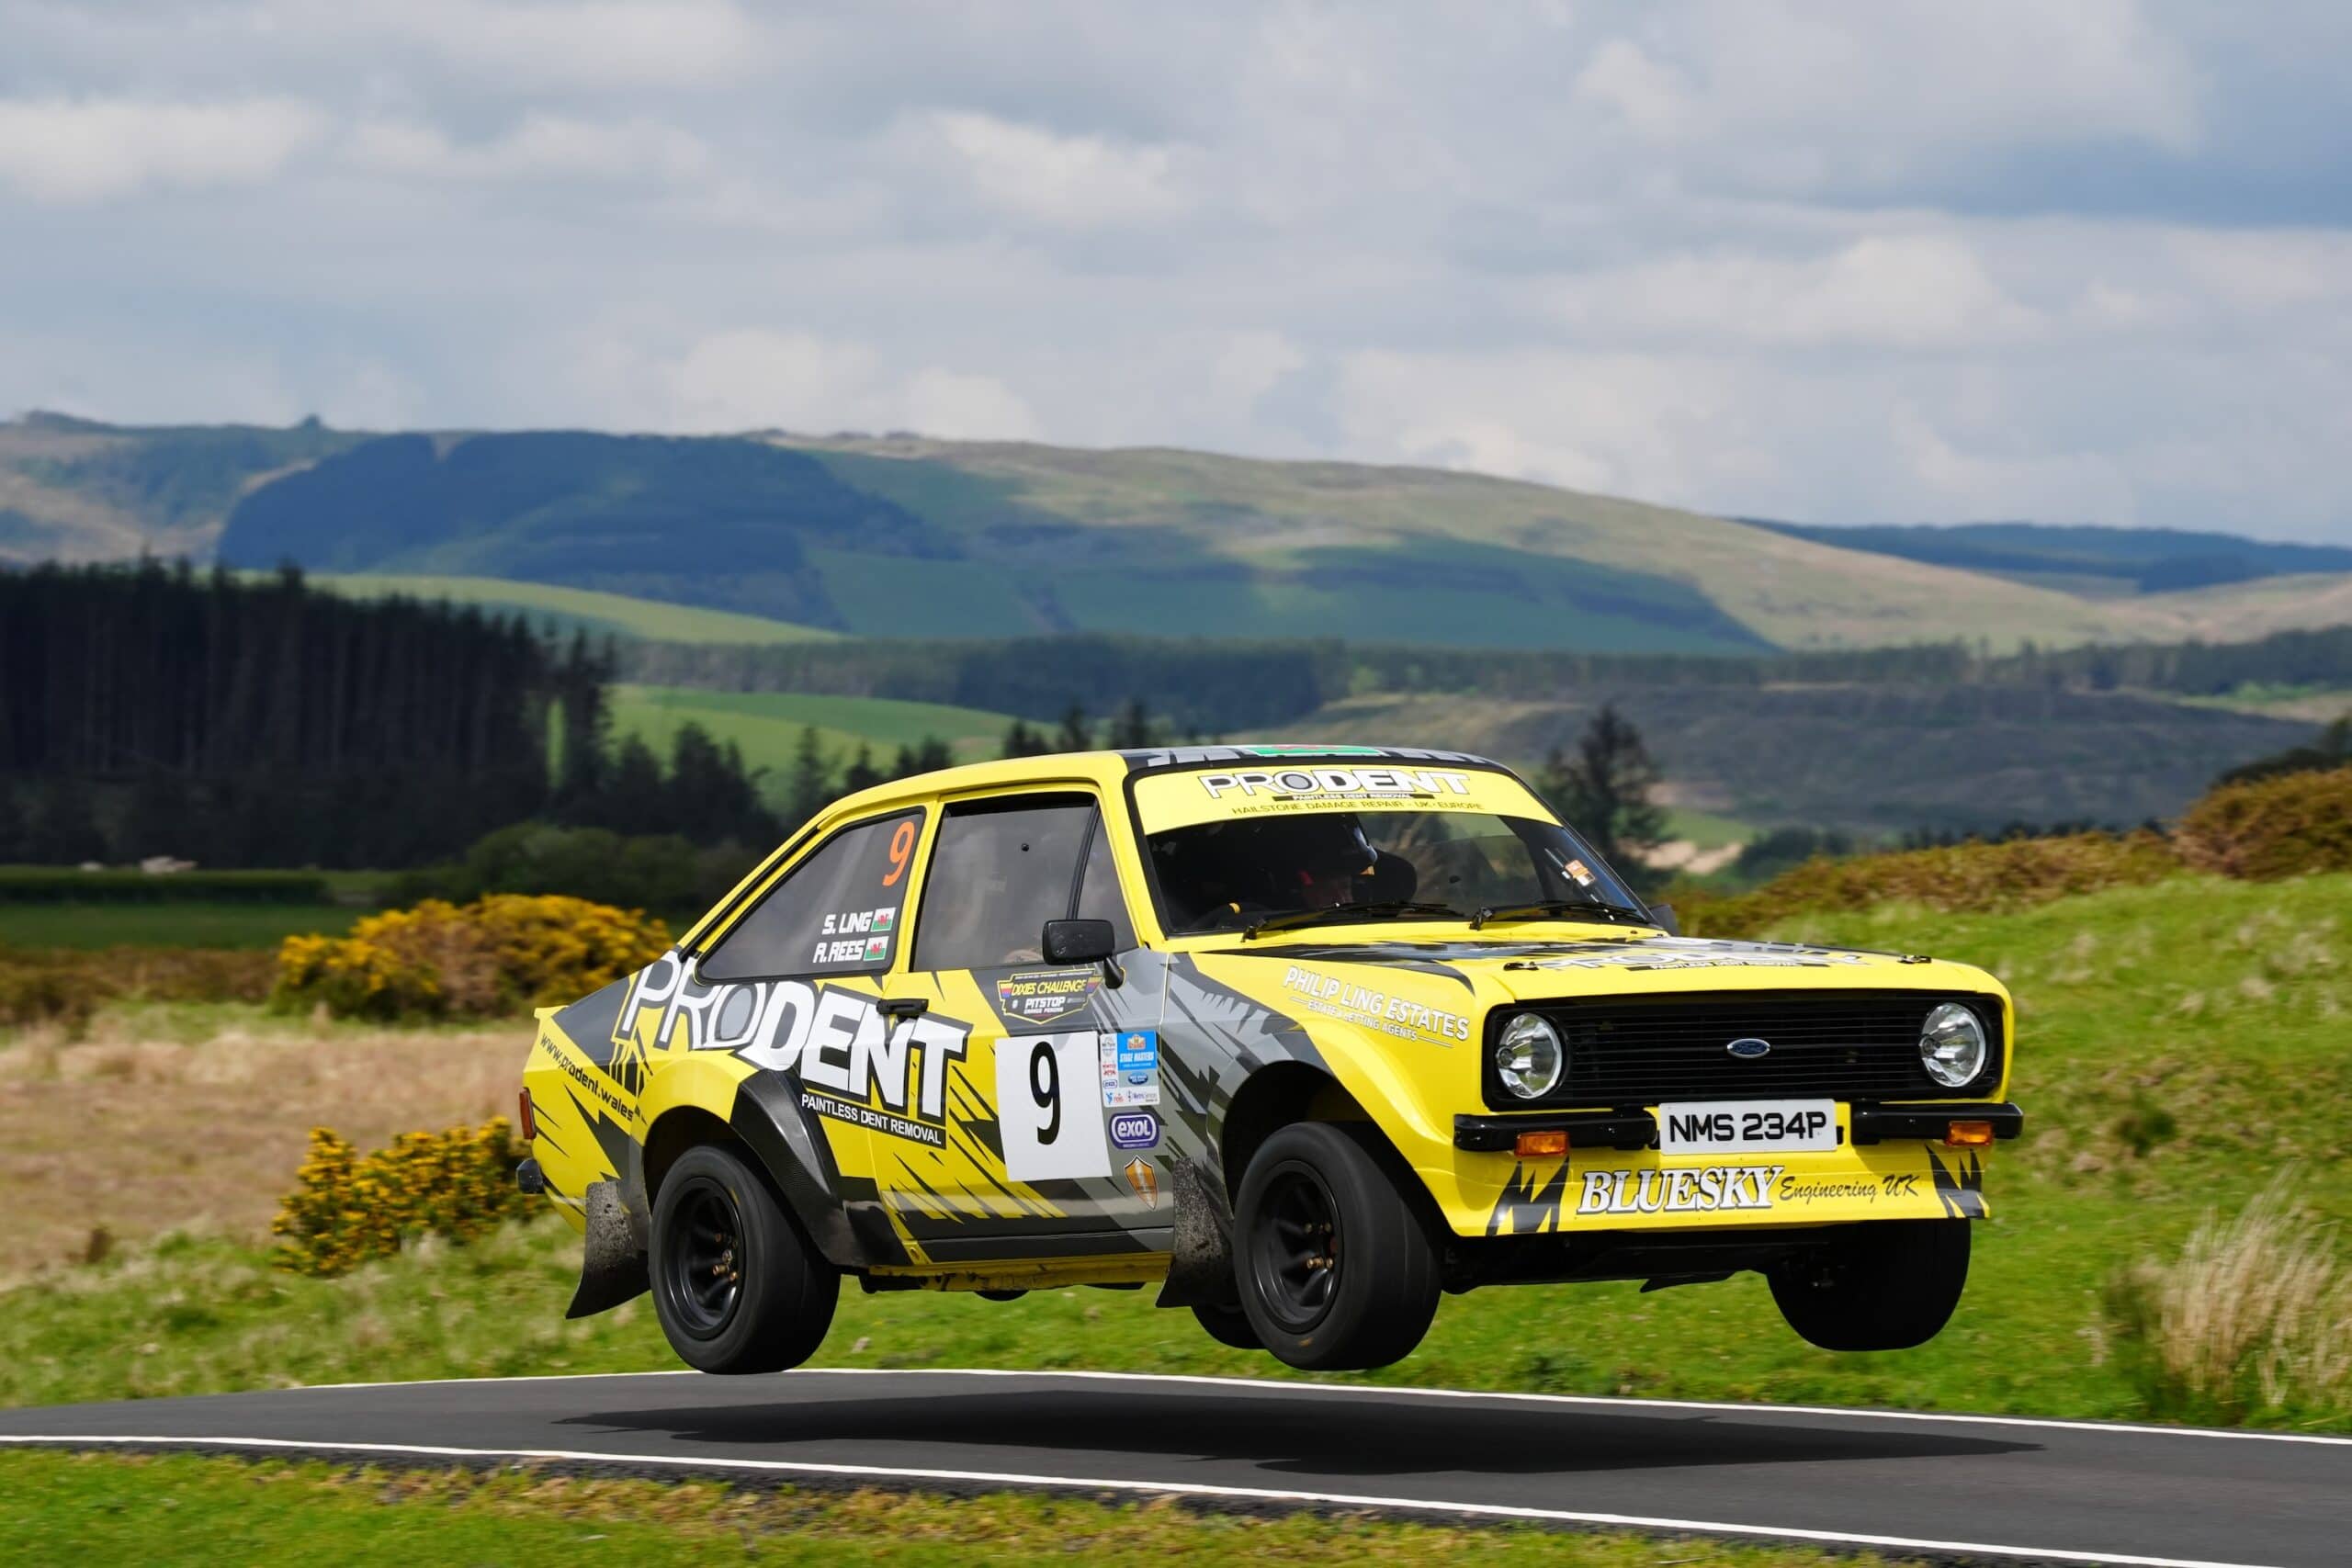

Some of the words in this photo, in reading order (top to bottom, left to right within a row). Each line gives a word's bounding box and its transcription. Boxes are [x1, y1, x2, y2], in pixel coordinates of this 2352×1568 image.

[1197, 769, 1470, 799] PRODENT
[1232, 803, 1304, 815] HAILSTONE
[1306, 802, 1356, 810] DAMAGE
[1362, 801, 1404, 809] REPAIR
[882, 821, 915, 886] 9
[838, 910, 875, 934] LING
[1012, 982, 1036, 996] DIXIES
[1037, 979, 1087, 995] CHALLENGE
[1024, 997, 1066, 1009] PITSTOP
[1283, 965, 1341, 1000] PHILIP
[1340, 983, 1384, 1015] LING
[1385, 998, 1470, 1042] ESTATES
[613, 949, 972, 1122] PRODENT
[1343, 1012, 1380, 1030] LETTING
[1382, 1022, 1419, 1041] AGENTS
[539, 1032, 634, 1122] www.prodent.wales
[1030, 1041, 1061, 1145] 9
[801, 1093, 858, 1122] PAINTLESS
[860, 1110, 888, 1130] DENT
[890, 1119, 942, 1145] REMOVAL
[1669, 1112, 1735, 1143] NMS
[1742, 1111, 1826, 1142] 234P
[1577, 1165, 1784, 1214] BLUESKY
[1779, 1175, 1876, 1207] Engineering
[1879, 1173, 1921, 1198] UK
